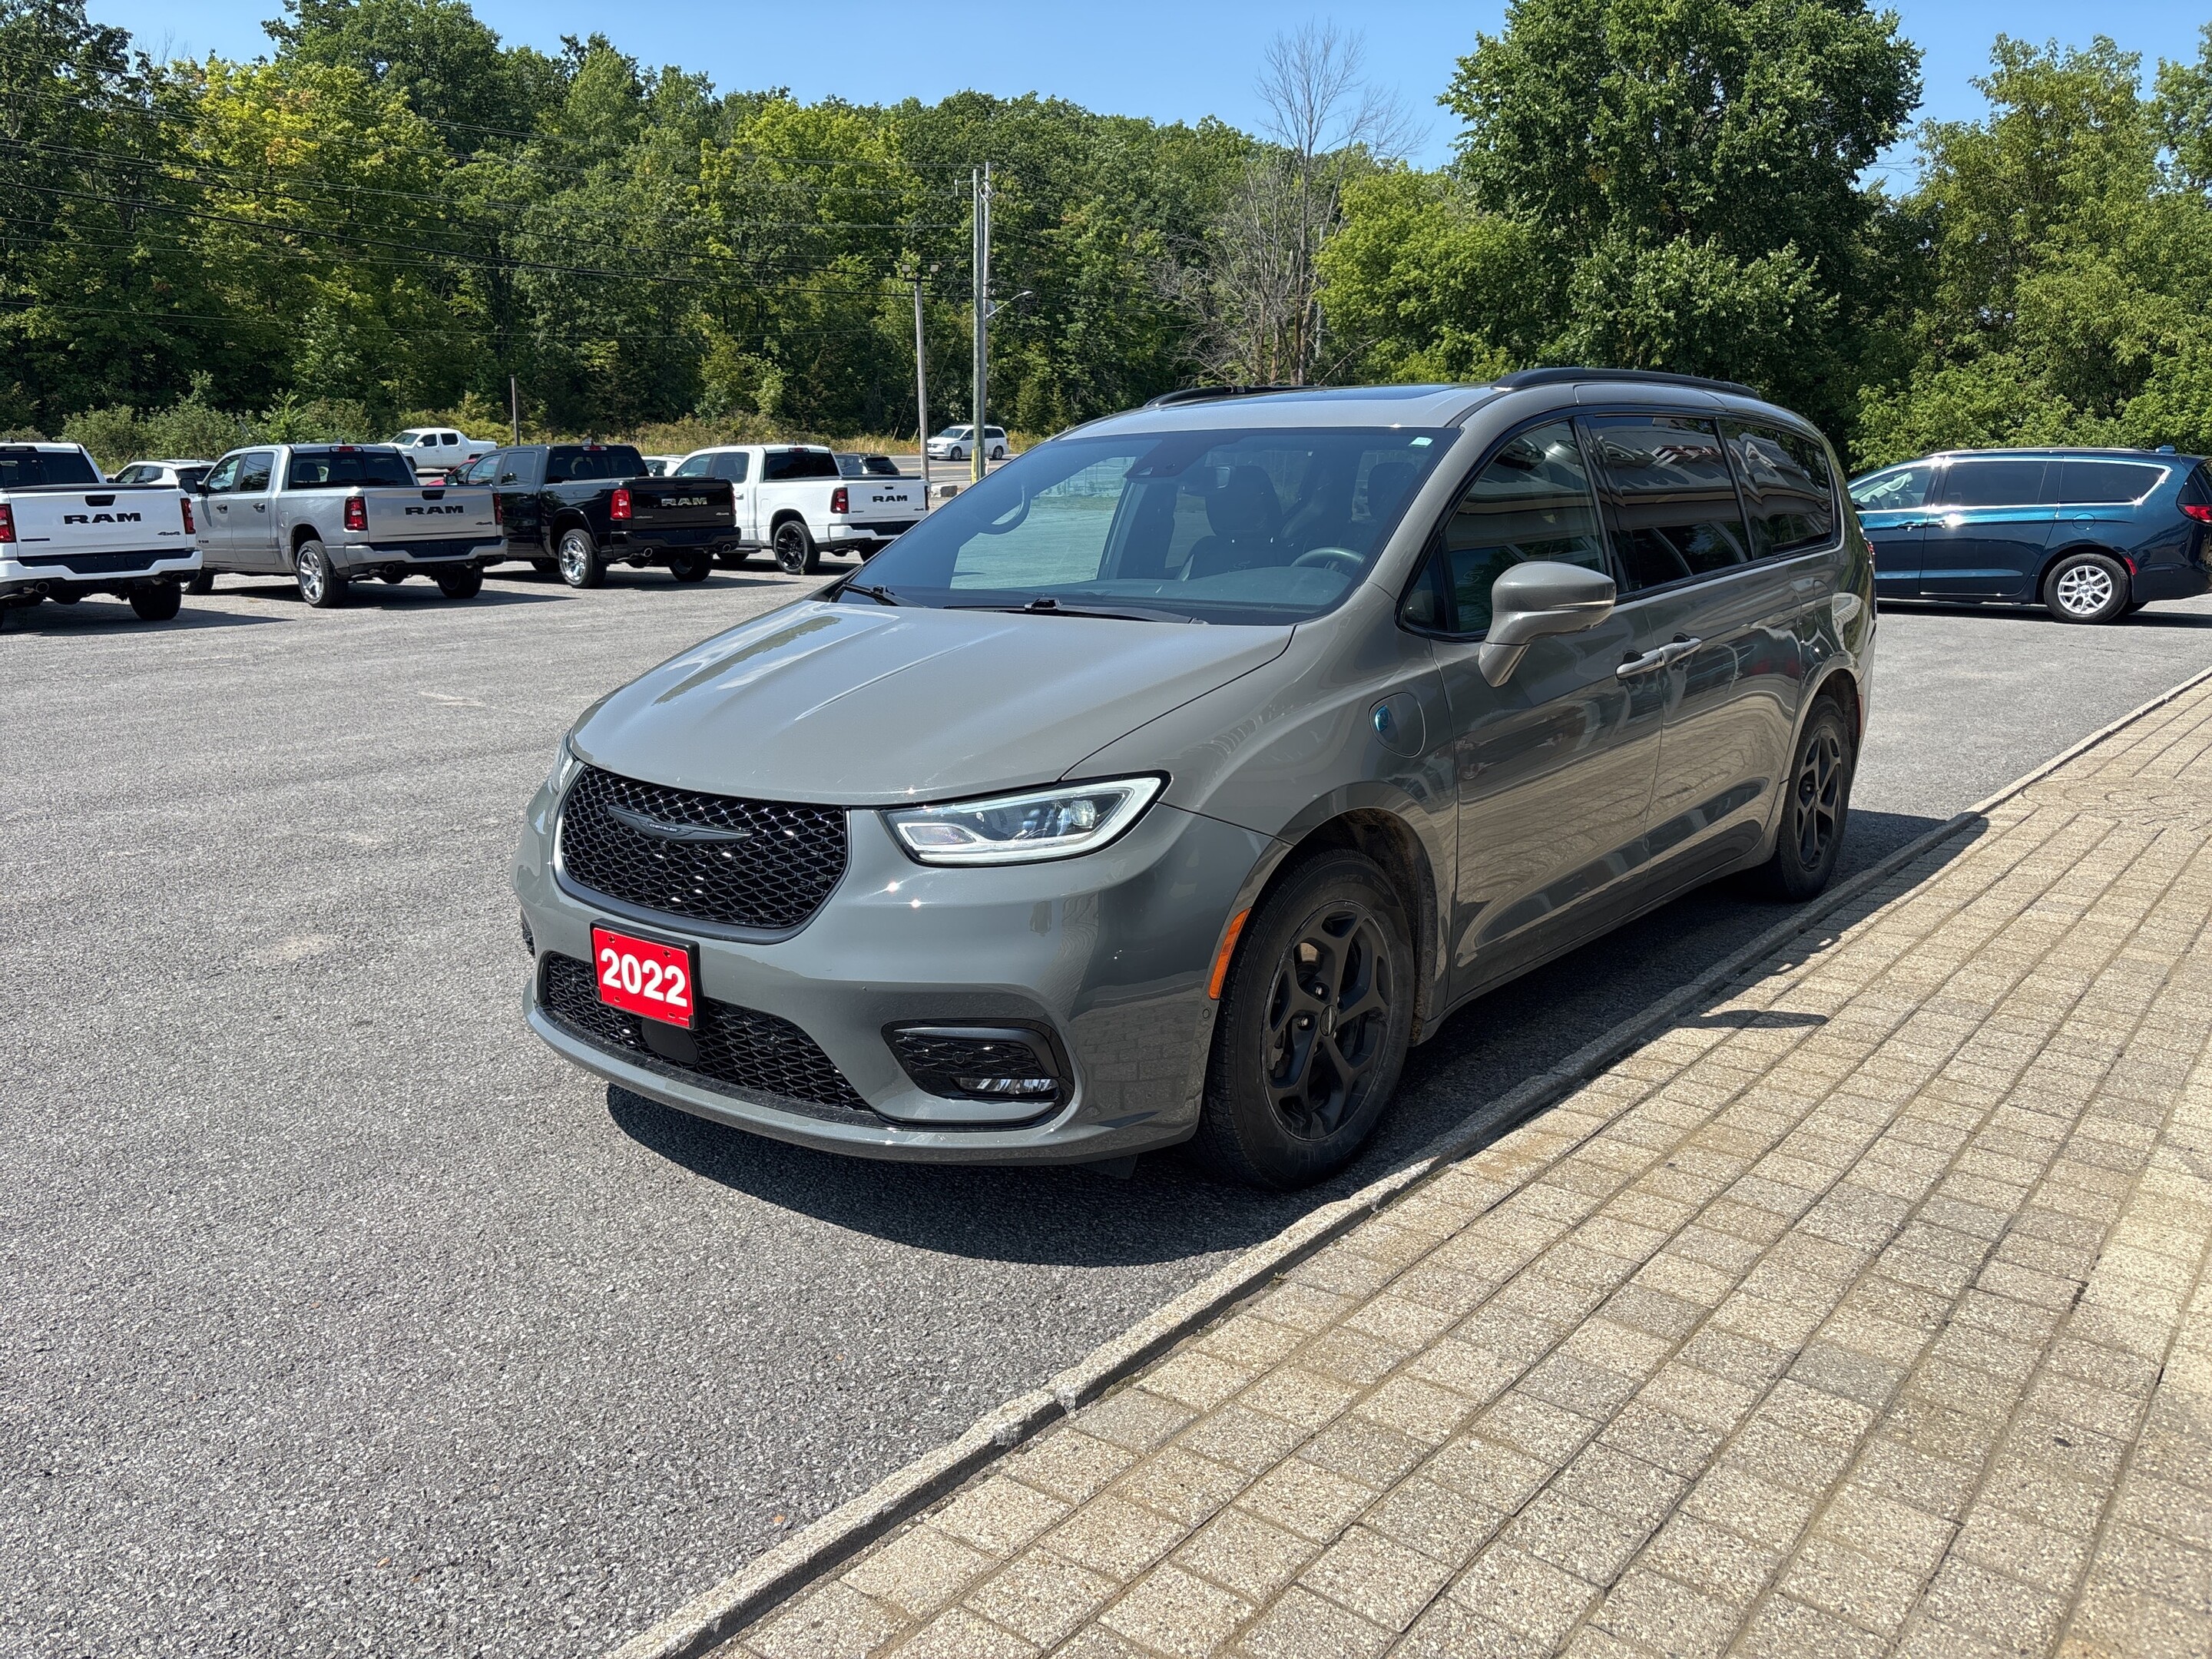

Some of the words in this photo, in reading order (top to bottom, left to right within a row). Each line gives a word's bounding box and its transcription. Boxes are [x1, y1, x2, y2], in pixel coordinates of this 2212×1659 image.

[661, 497, 708, 506] RAM
[405, 505, 464, 515] RAM
[64, 512, 142, 525] RAM
[600, 947, 688, 1008] 2022
